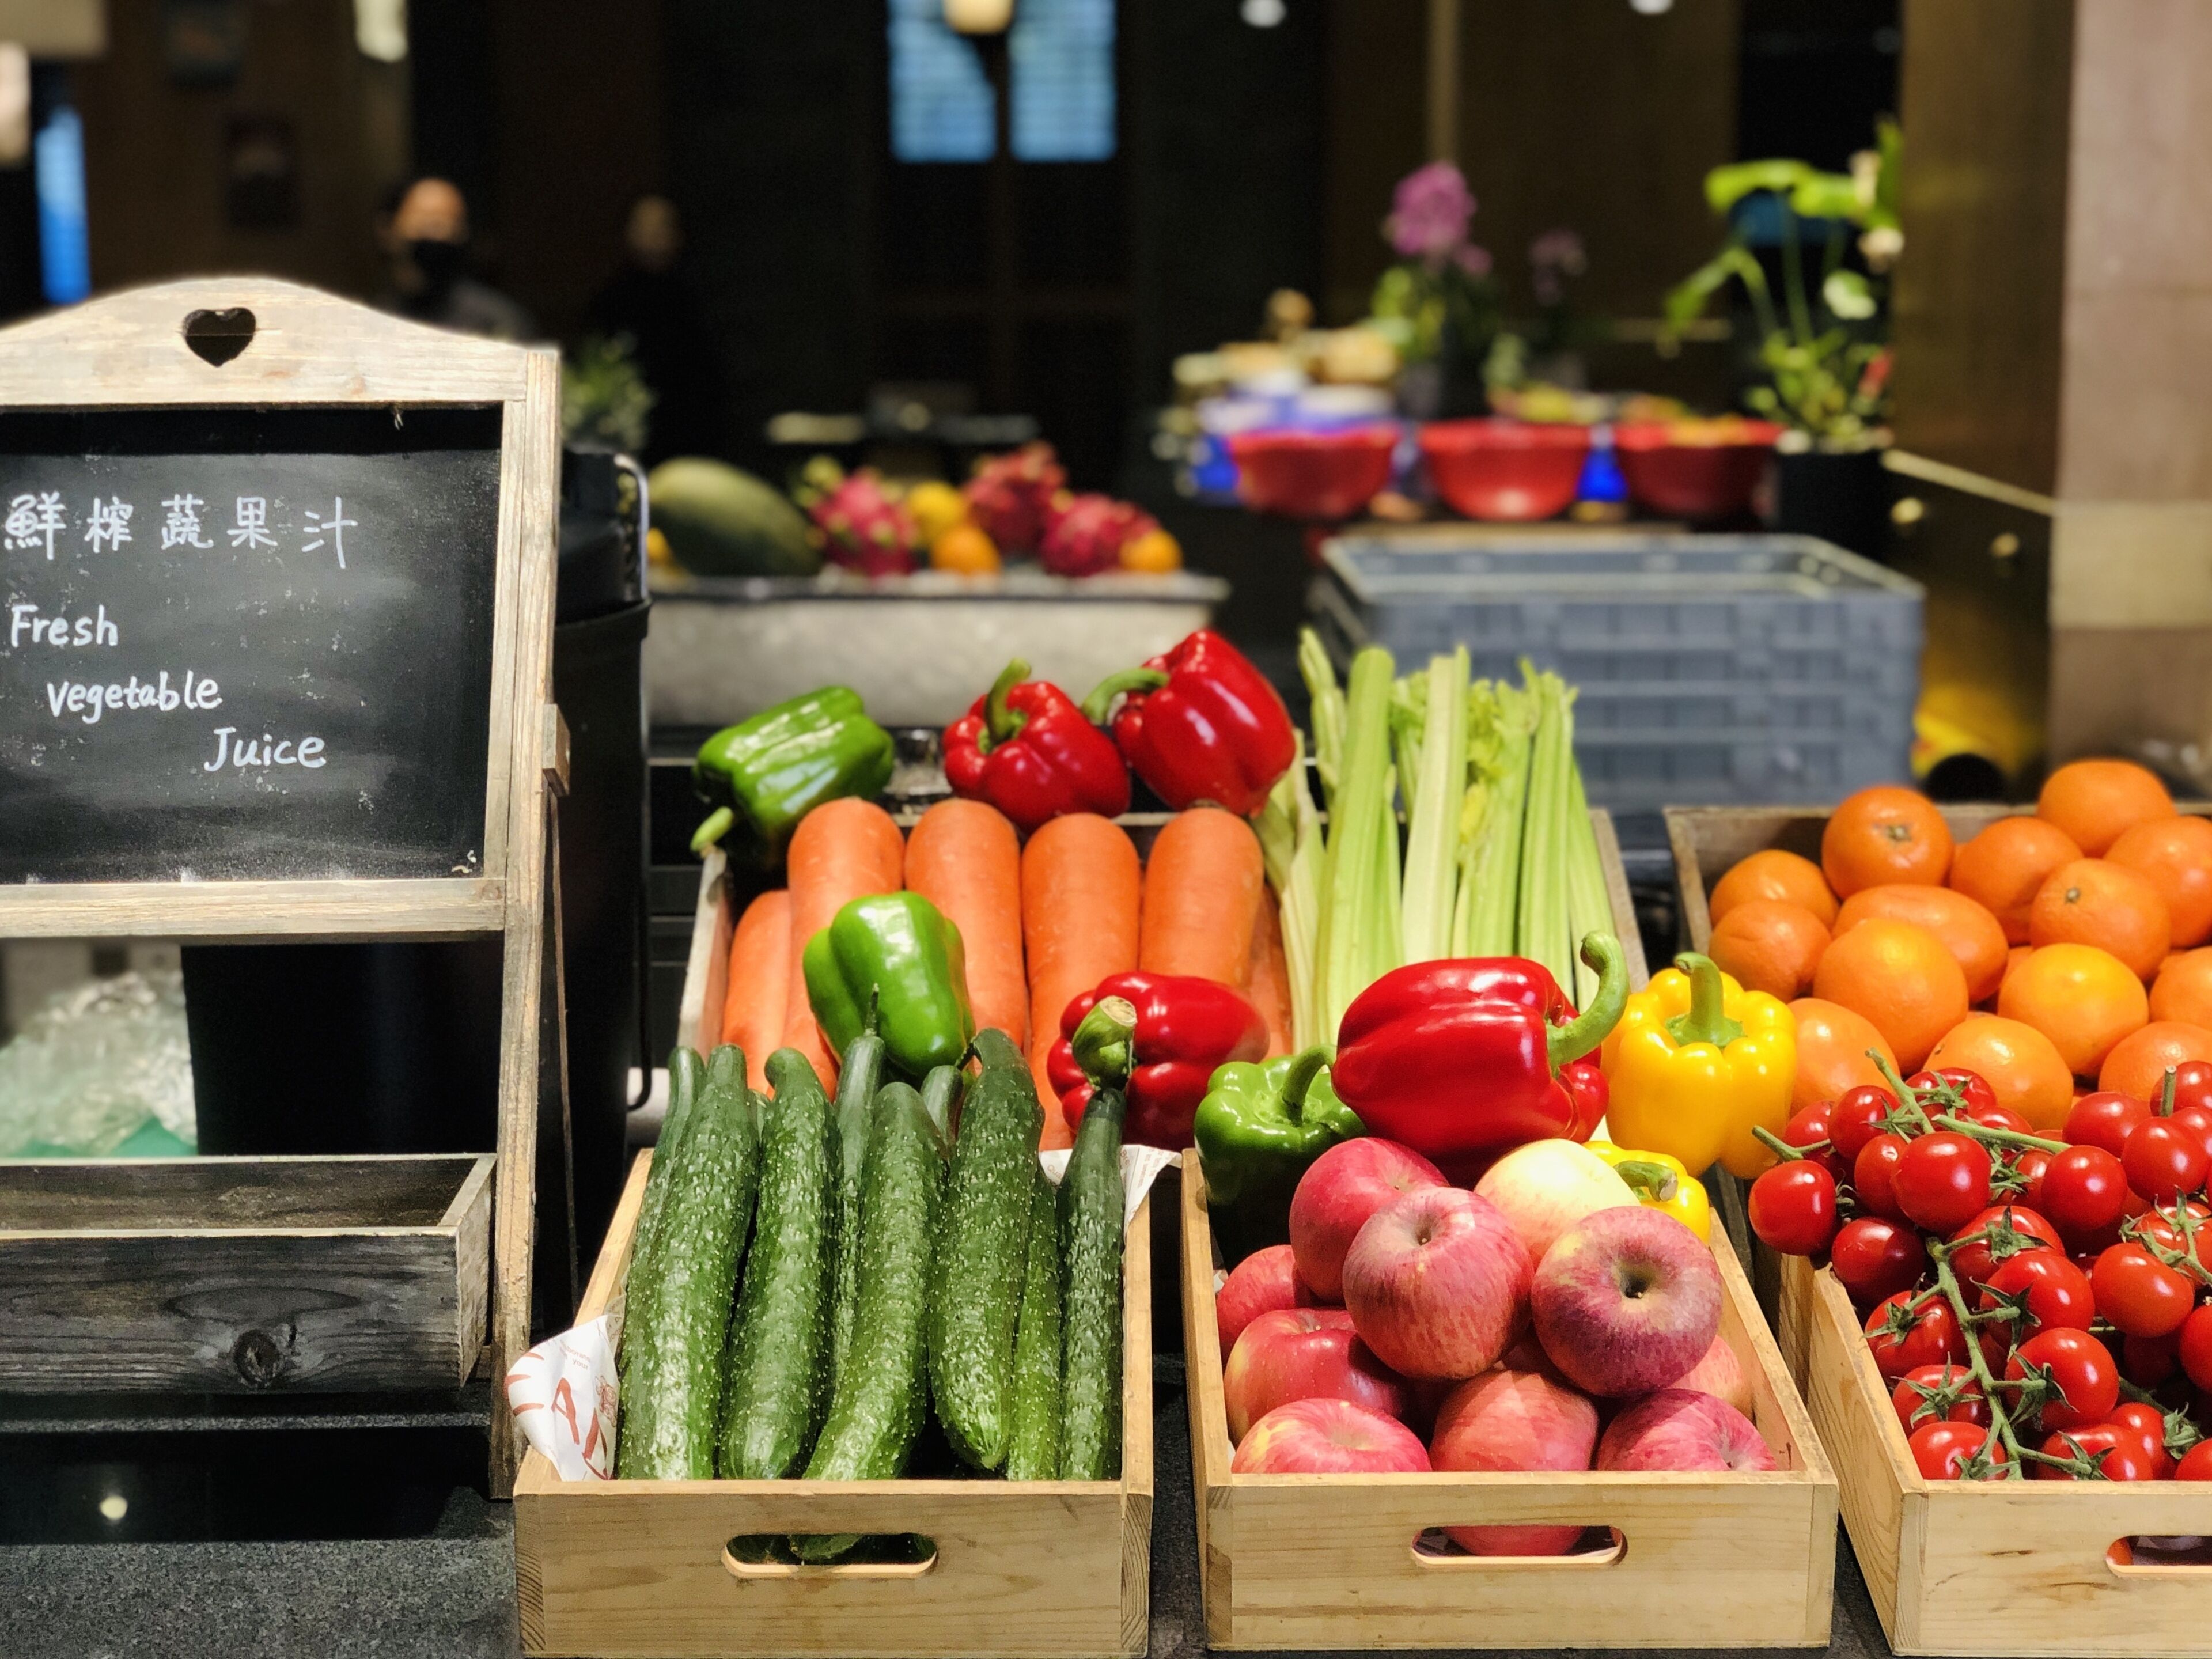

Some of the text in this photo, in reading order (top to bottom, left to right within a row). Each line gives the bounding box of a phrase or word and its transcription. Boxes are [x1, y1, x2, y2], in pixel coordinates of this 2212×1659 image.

[5, 491, 358, 569] 鮮榨蔬果汁
[11, 605, 118, 647] Fresh
[203, 726, 327, 772] Juice
